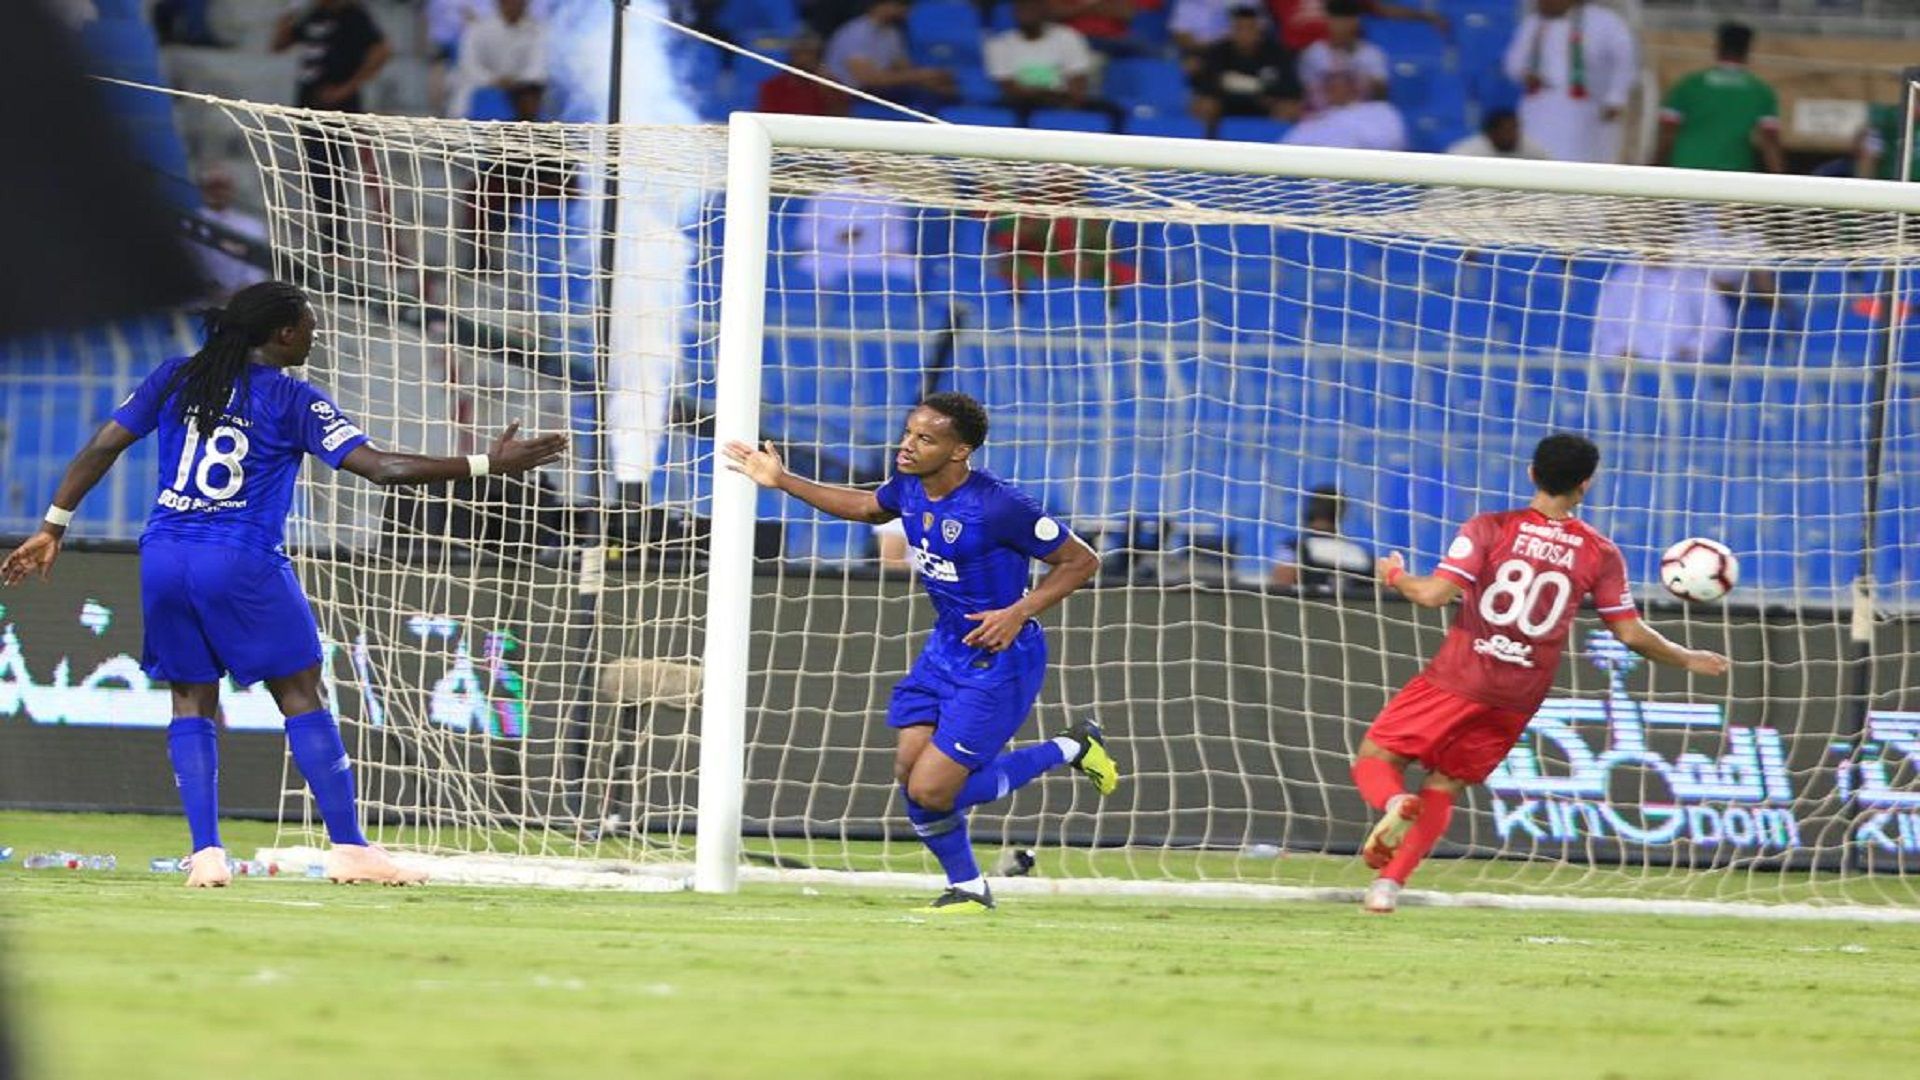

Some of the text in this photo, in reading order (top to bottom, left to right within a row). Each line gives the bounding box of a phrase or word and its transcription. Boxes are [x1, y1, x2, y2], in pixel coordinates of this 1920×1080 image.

[174, 415, 248, 500] 18
[1512, 533, 1575, 570] F.ROSA
[1479, 559, 1572, 638] 80
